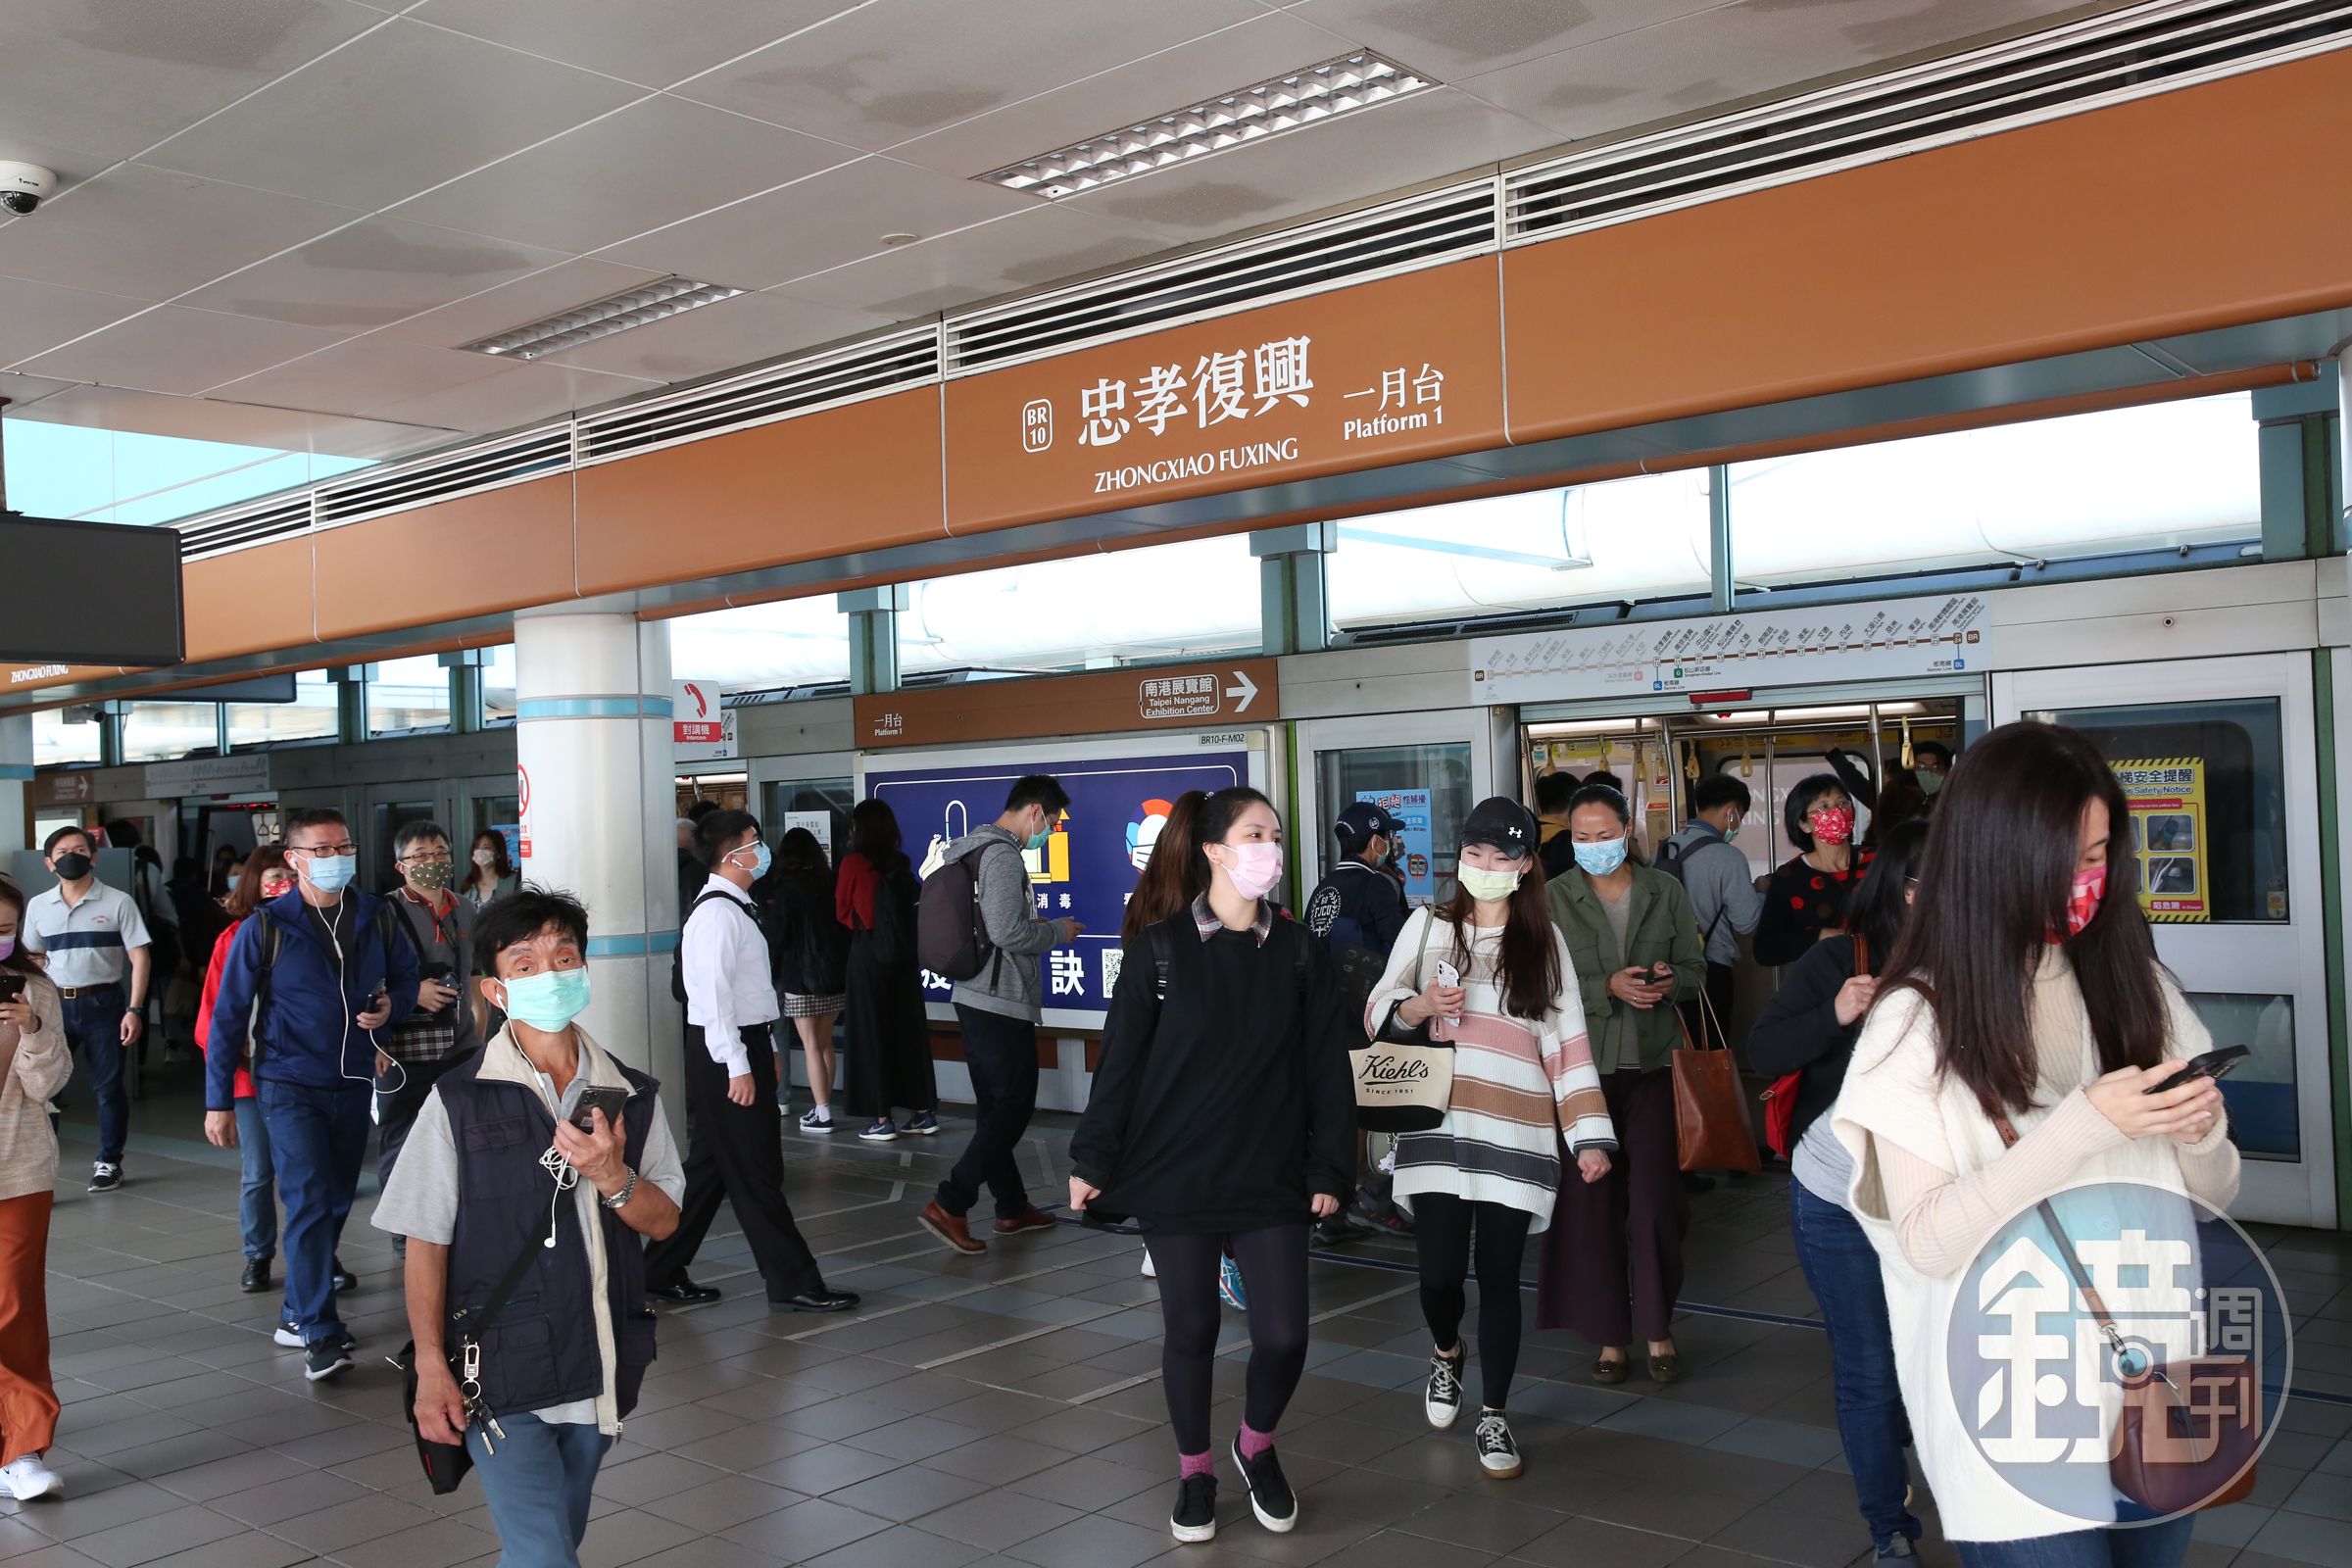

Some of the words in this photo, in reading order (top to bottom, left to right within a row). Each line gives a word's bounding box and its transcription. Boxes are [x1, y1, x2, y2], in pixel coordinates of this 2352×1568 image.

[1078, 334, 1315, 448] 忠孝復興
[1343, 362, 1445, 413] 一月台
[1026, 407, 1048, 424] BR
[1343, 411, 1428, 441] Platform
[1433, 404, 1445, 424] 1
[1029, 426, 1047, 447] 10
[1094, 451, 1215, 495] ZHONGXIAO
[1219, 437, 1299, 472] FUXING
[11, 666, 46, 683] ZHONGXIAO
[1145, 677, 1213, 697] 南港展覽館
[1146, 707, 1184, 716] Exhibition
[1187, 705, 1214, 713] Center
[1149, 698, 1172, 707] Taipei
[1174, 696, 1210, 706] Nangang
[874, 713, 902, 727] 一月台
[682, 724, 710, 735] 對講機
[1200, 734, 1245, 744] BR10-F-M02
[1037, 893, 1071, 909] 消毒
[1049, 949, 1085, 996] 訣
[1358, 1054, 1429, 1079] Kiehl's
